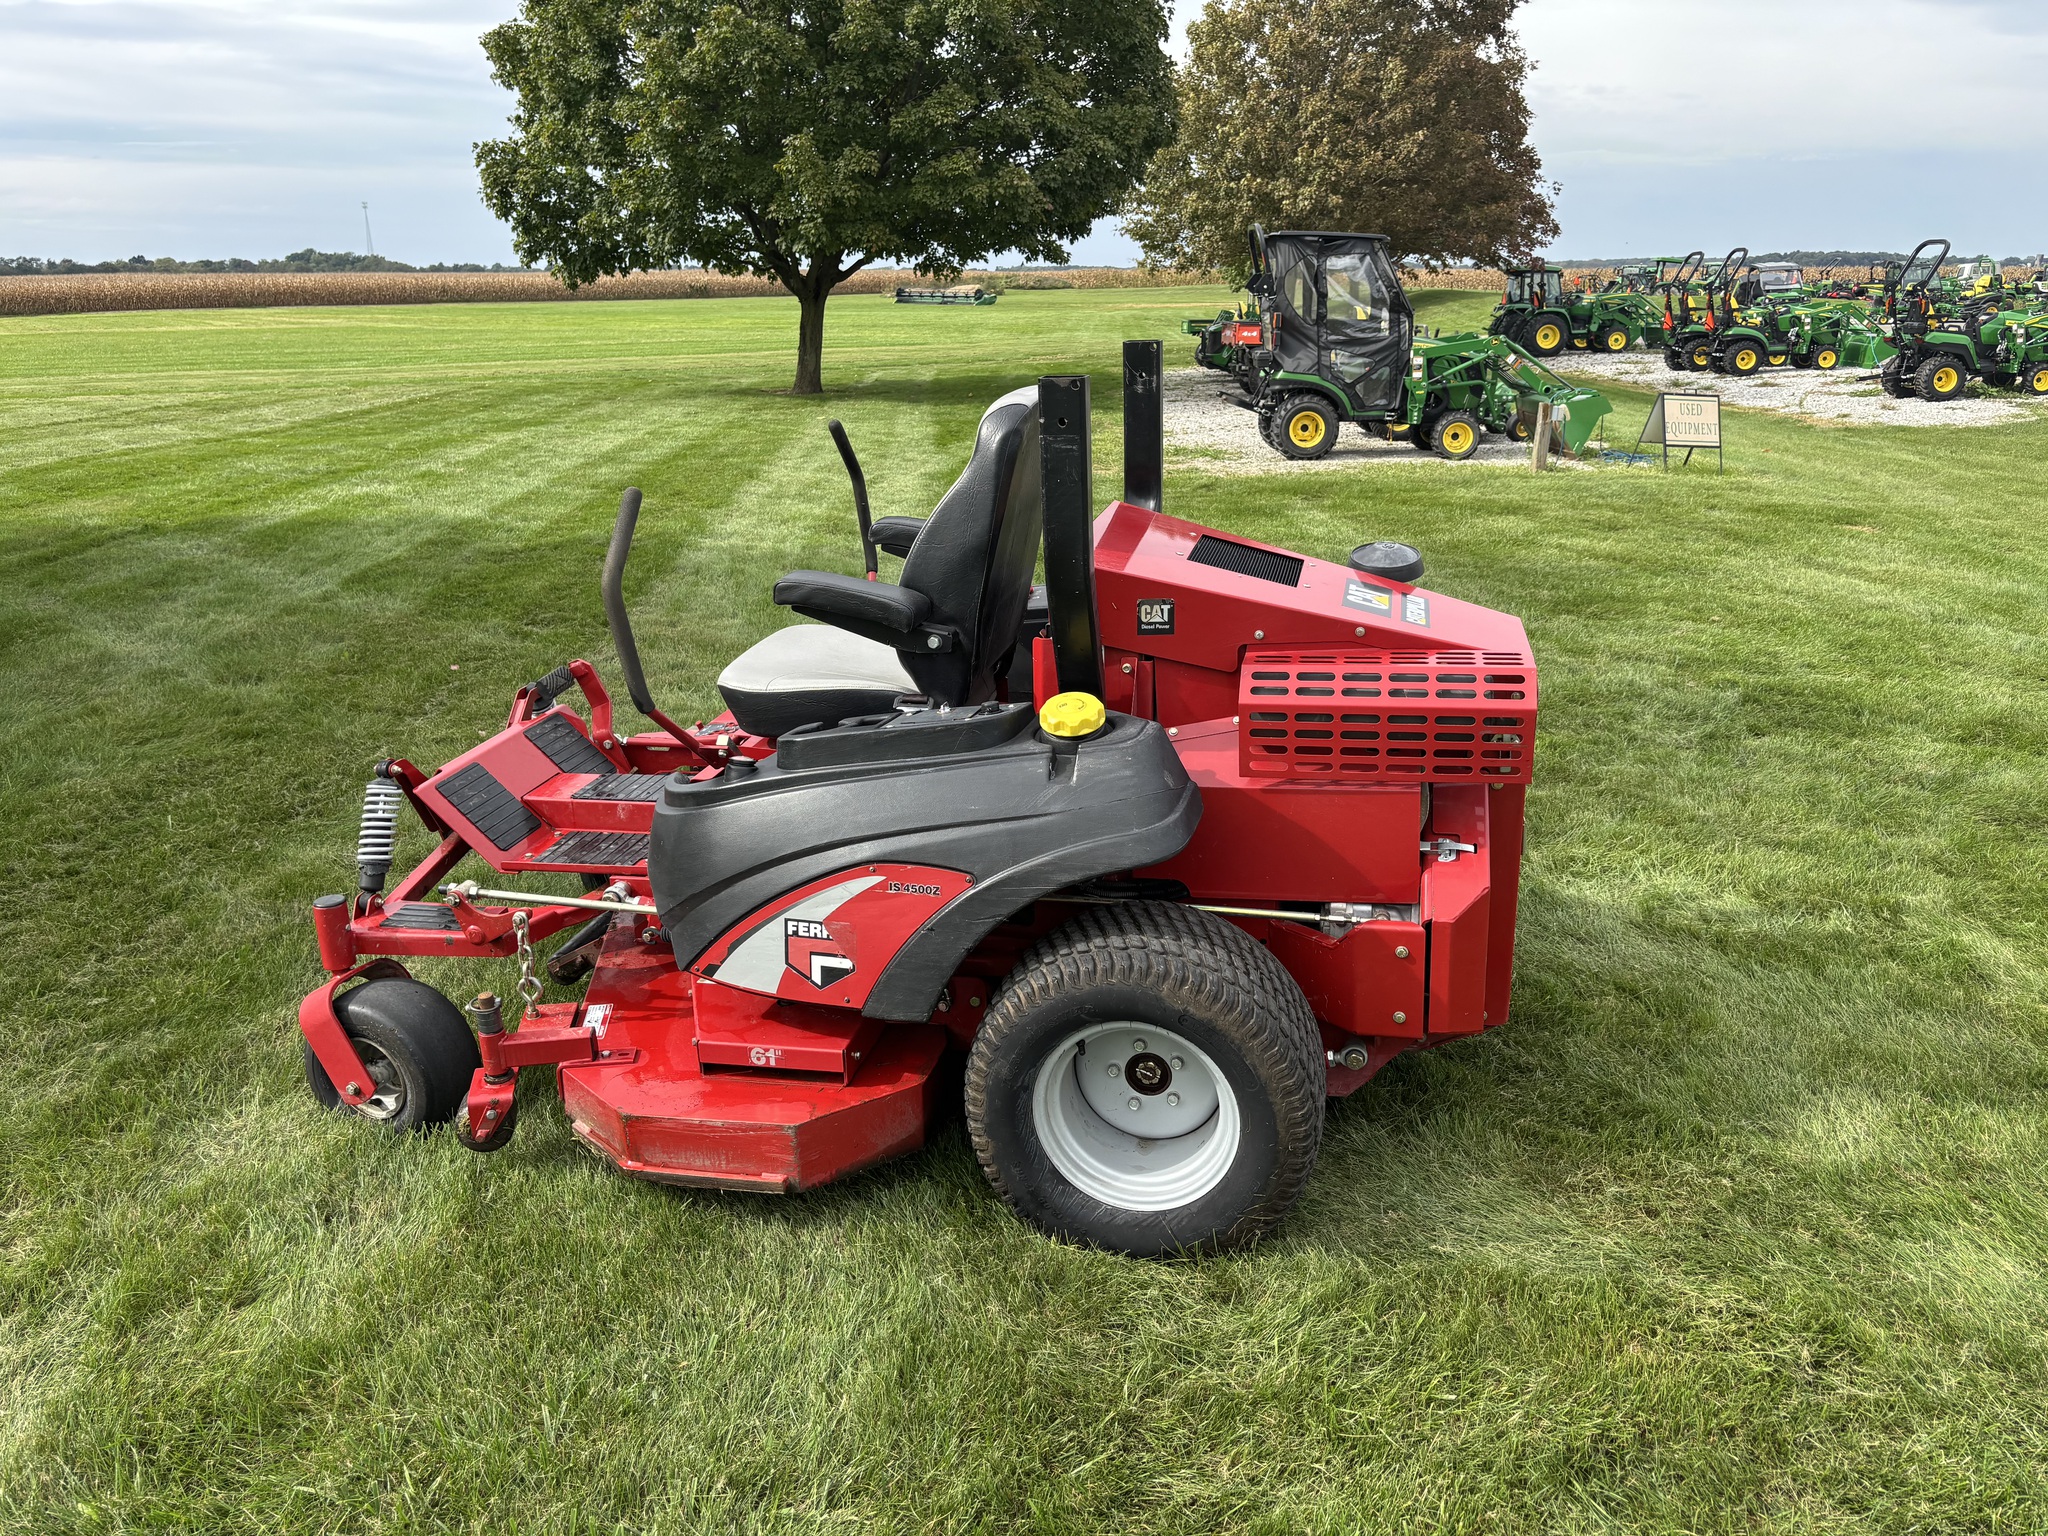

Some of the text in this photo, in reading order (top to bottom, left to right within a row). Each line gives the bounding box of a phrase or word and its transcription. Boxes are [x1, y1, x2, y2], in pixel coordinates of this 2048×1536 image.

[1679, 403, 1702, 416] USED
[1665, 421, 1718, 437] EQUIPMENT
[1346, 583, 1390, 610] CAT
[1140, 604, 1171, 623] CAT
[889, 882, 940, 896] IS 4500Z
